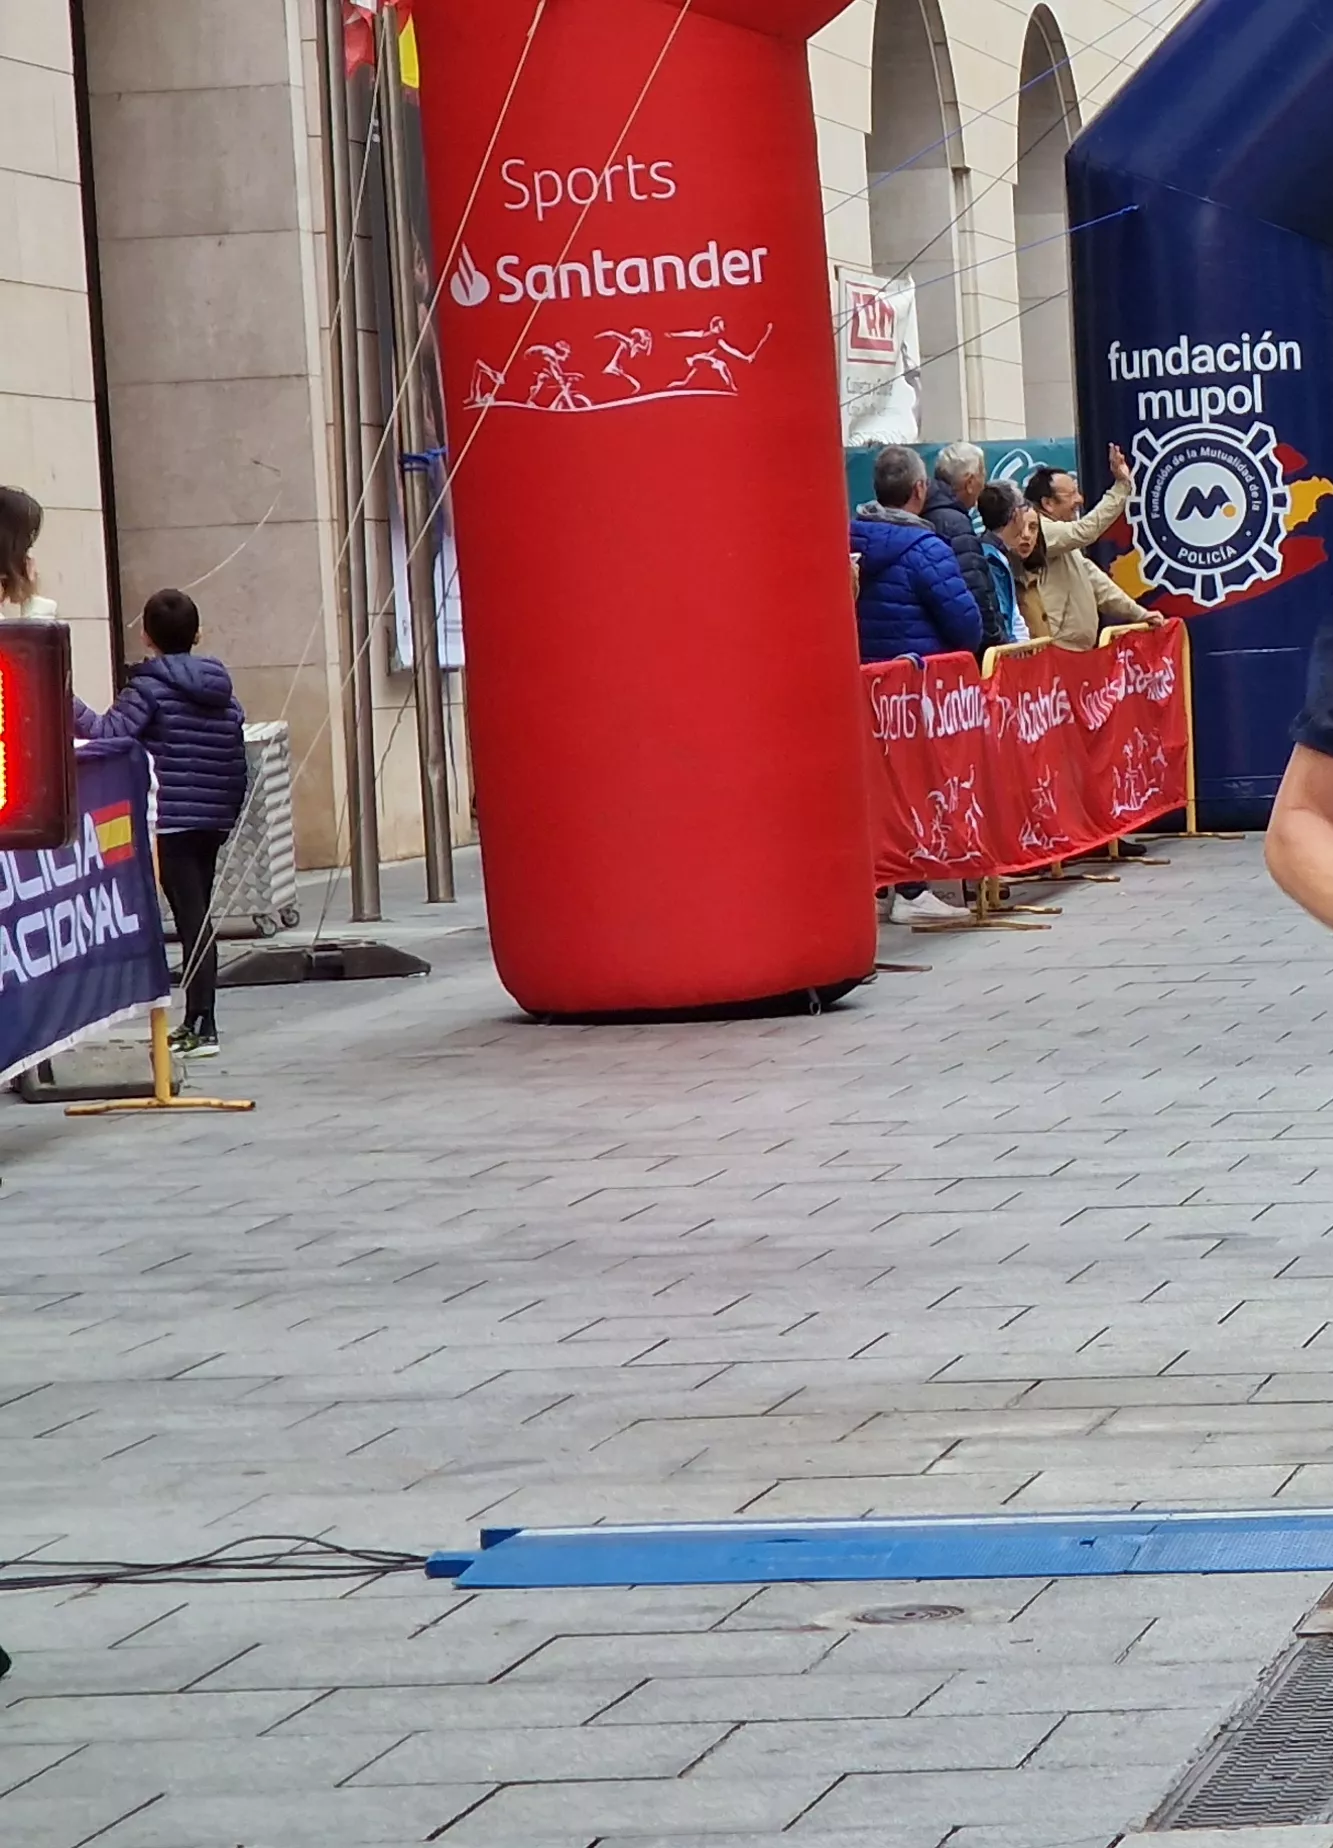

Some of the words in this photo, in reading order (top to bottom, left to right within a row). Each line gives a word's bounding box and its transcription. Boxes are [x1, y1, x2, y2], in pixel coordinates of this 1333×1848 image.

[501, 154, 677, 222] Sports
[496, 239, 768, 304] Santander
[1107, 330, 1302, 381] fundación
[1137, 373, 1263, 424] mupol
[1171, 453, 1185, 467] de
[1186, 448, 1197, 460] la
[1200, 446, 1256, 483] Mutualidad
[1151, 462, 1173, 519] Fundación
[1248, 482, 1260, 497] de
[1251, 500, 1262, 512] la
[1177, 544, 1238, 565] POLICÍA
